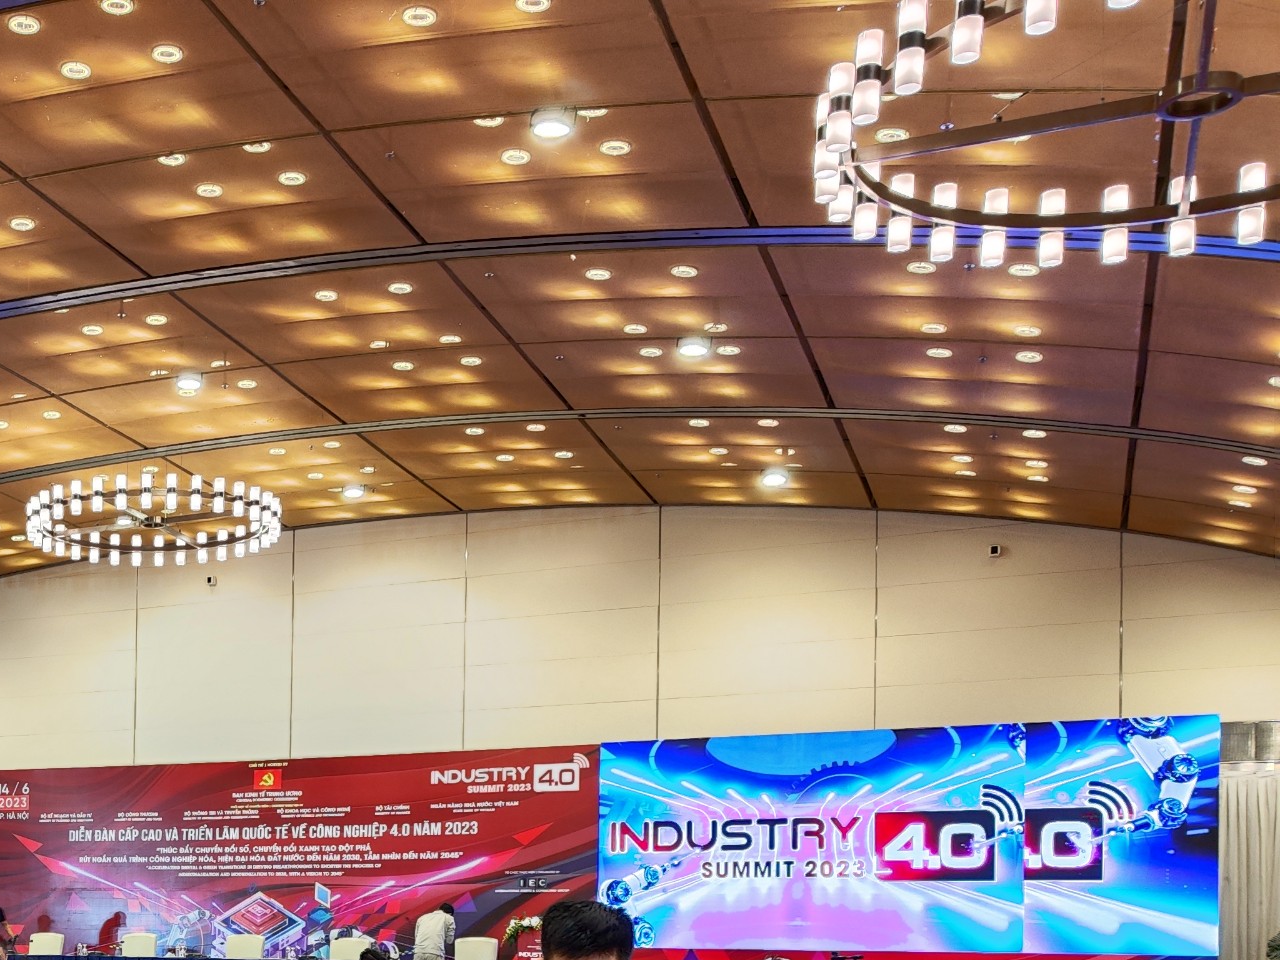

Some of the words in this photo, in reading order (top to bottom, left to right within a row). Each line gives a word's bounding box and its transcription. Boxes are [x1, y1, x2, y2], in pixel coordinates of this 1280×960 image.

[431, 766, 530, 785] INDUSTRY
[538, 769, 575, 786] 4.0
[467, 784, 505, 793] SUMMIT
[507, 783, 531, 792] 2023
[68, 826, 92, 841] DIỄN
[94, 827, 115, 841] ĐÀN
[118, 826, 139, 841] CẤP
[141, 829, 163, 841] CAO
[165, 826, 179, 841] VÀ
[181, 824, 213, 840] TRIỂN
[216, 826, 240, 840] LÃM
[242, 824, 272, 840] QUỐC
[274, 823, 291, 839] TẾ
[292, 823, 308, 839] VỀ
[309, 823, 340, 838] CÔNG
[344, 822, 387, 839] NGHIỆP
[390, 823, 410, 837] 4.0
[413, 820, 441, 836] NĂM
[444, 821, 478, 835] 2023
[321, 845, 336, 854] TẠO
[338, 844, 354, 853] ĐỘT
[355, 843, 371, 851] PHÁ
[609, 816, 861, 854] INDUSTRY
[882, 822, 990, 870] 4.0
[79, 855, 91, 863] RÚT
[129, 854, 148, 863] TRÌNH
[149, 855, 170, 863] CÔNG
[172, 855, 197, 864] NGHIỆP
[217, 854, 234, 863] HIỆN
[235, 855, 247, 863] ĐẠI
[249, 854, 266, 862] HÓA
[267, 852, 281, 861] ĐẤT
[283, 853, 305, 861] NƯỚC
[306, 852, 321, 861] ĐẾN
[323, 853, 340, 861] NĂM
[382, 852, 401, 860] NHÌN
[403, 850, 418, 860] ĐẾN
[420, 851, 438, 860] NĂM
[701, 861, 794, 879] SUMMIT
[805, 861, 867, 879] 2023
